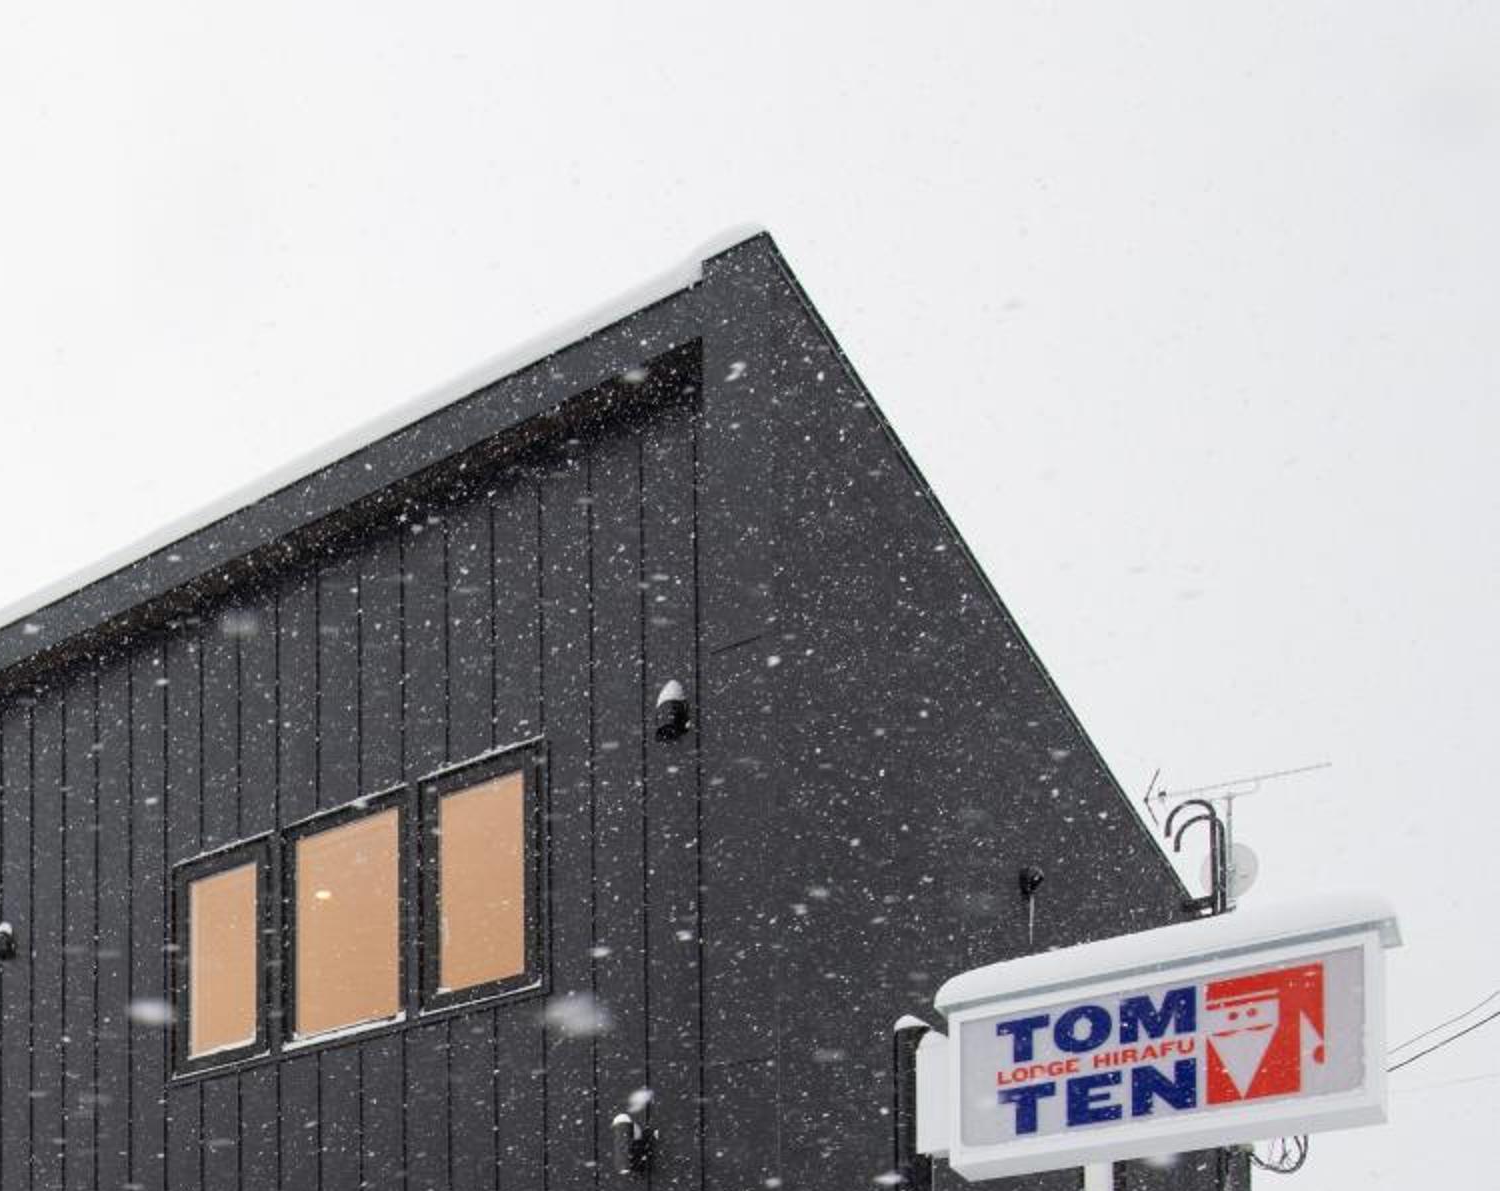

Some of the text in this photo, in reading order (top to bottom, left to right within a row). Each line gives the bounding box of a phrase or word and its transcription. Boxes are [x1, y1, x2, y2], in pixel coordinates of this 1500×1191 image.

[997, 986, 1196, 1063] TOM
[997, 1037, 1195, 1085] LODGE HIRAFU
[998, 1058, 1196, 1135] TEN
